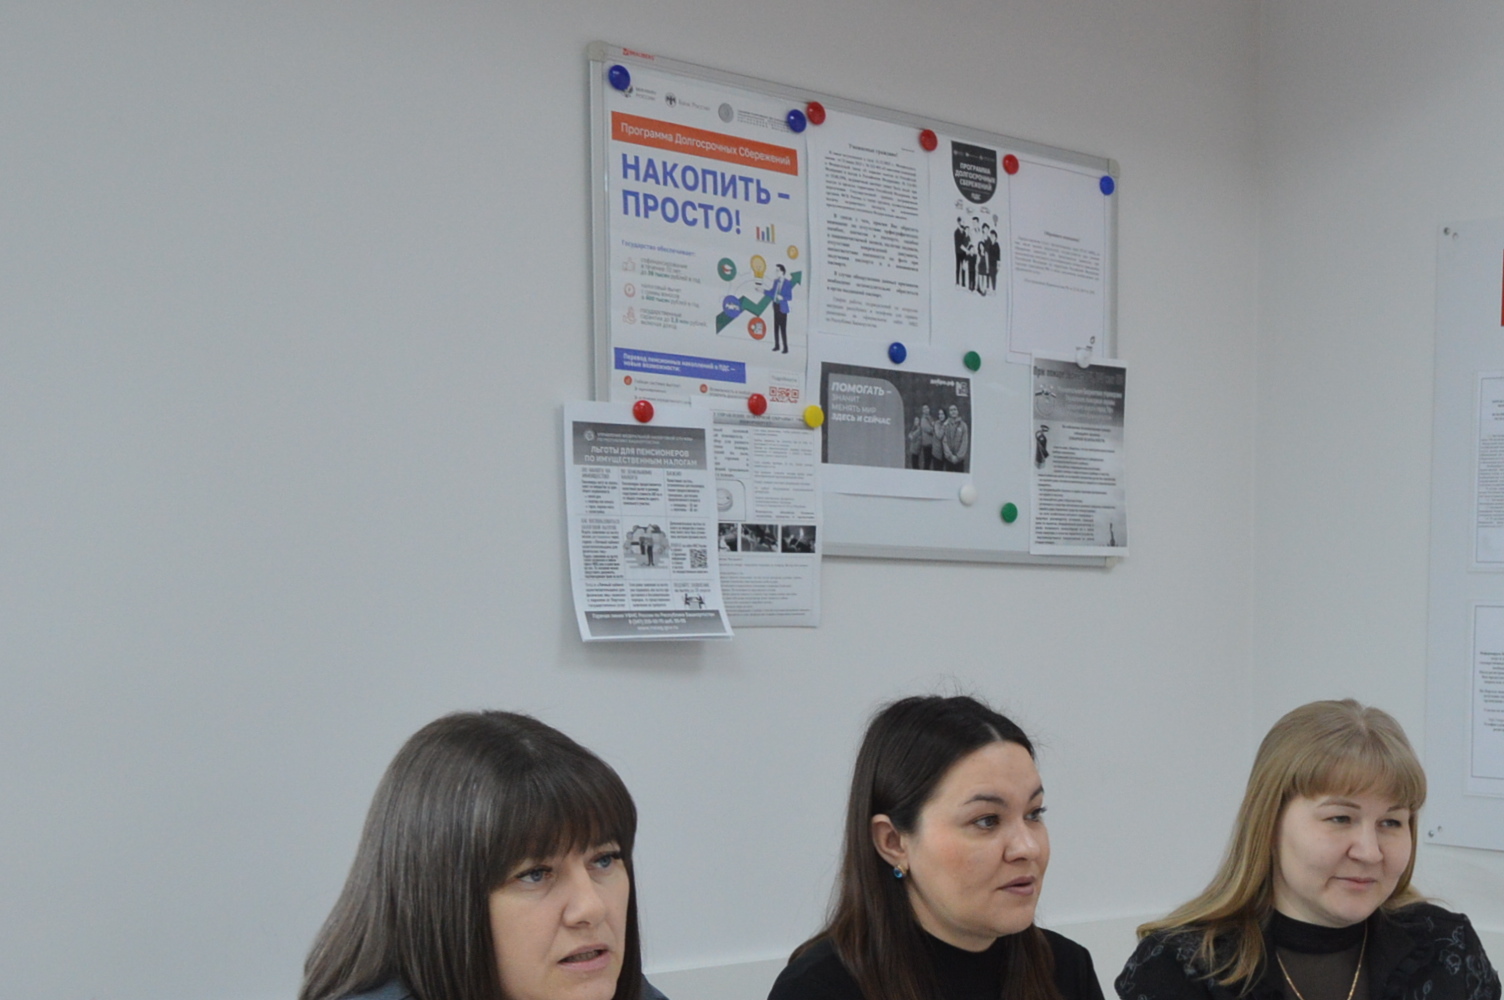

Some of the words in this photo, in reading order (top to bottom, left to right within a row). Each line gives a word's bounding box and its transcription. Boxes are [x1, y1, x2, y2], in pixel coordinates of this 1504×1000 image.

[620, 122, 674, 142] Программа
[675, 133, 738, 155] Долгосрочных
[739, 146, 791, 166] Сбережений
[959, 162, 991, 175] ПРОГРАММА
[621, 152, 772, 206] НАКОПИТЬ
[954, 169, 996, 184] ДОЛГОСРОЧНЫХ
[959, 178, 993, 192] СБЕРЕЖЕНИЙ
[621, 189, 741, 235] ПРОСТО!
[831, 381, 884, 396] ПОМОГАТЬ
[831, 393, 860, 403] ЗНАЧИТ
[831, 403, 861, 413] МЕНЯТЬ
[861, 406, 877, 414] МИР
[831, 412, 856, 423] ЗДЕСЬ
[863, 414, 892, 425] СЕЙЧАС
[591, 445, 619, 454] ЛЬГОТЫ
[620, 447, 635, 456] ДЛЯ
[635, 447, 689, 457] ПЕНСИОНЕРОВ
[584, 454, 595, 462] ПО
[596, 455, 662, 466] ИМУЩЕСТВЕННЫМ
[663, 457, 697, 467] НАЛОГАМ
